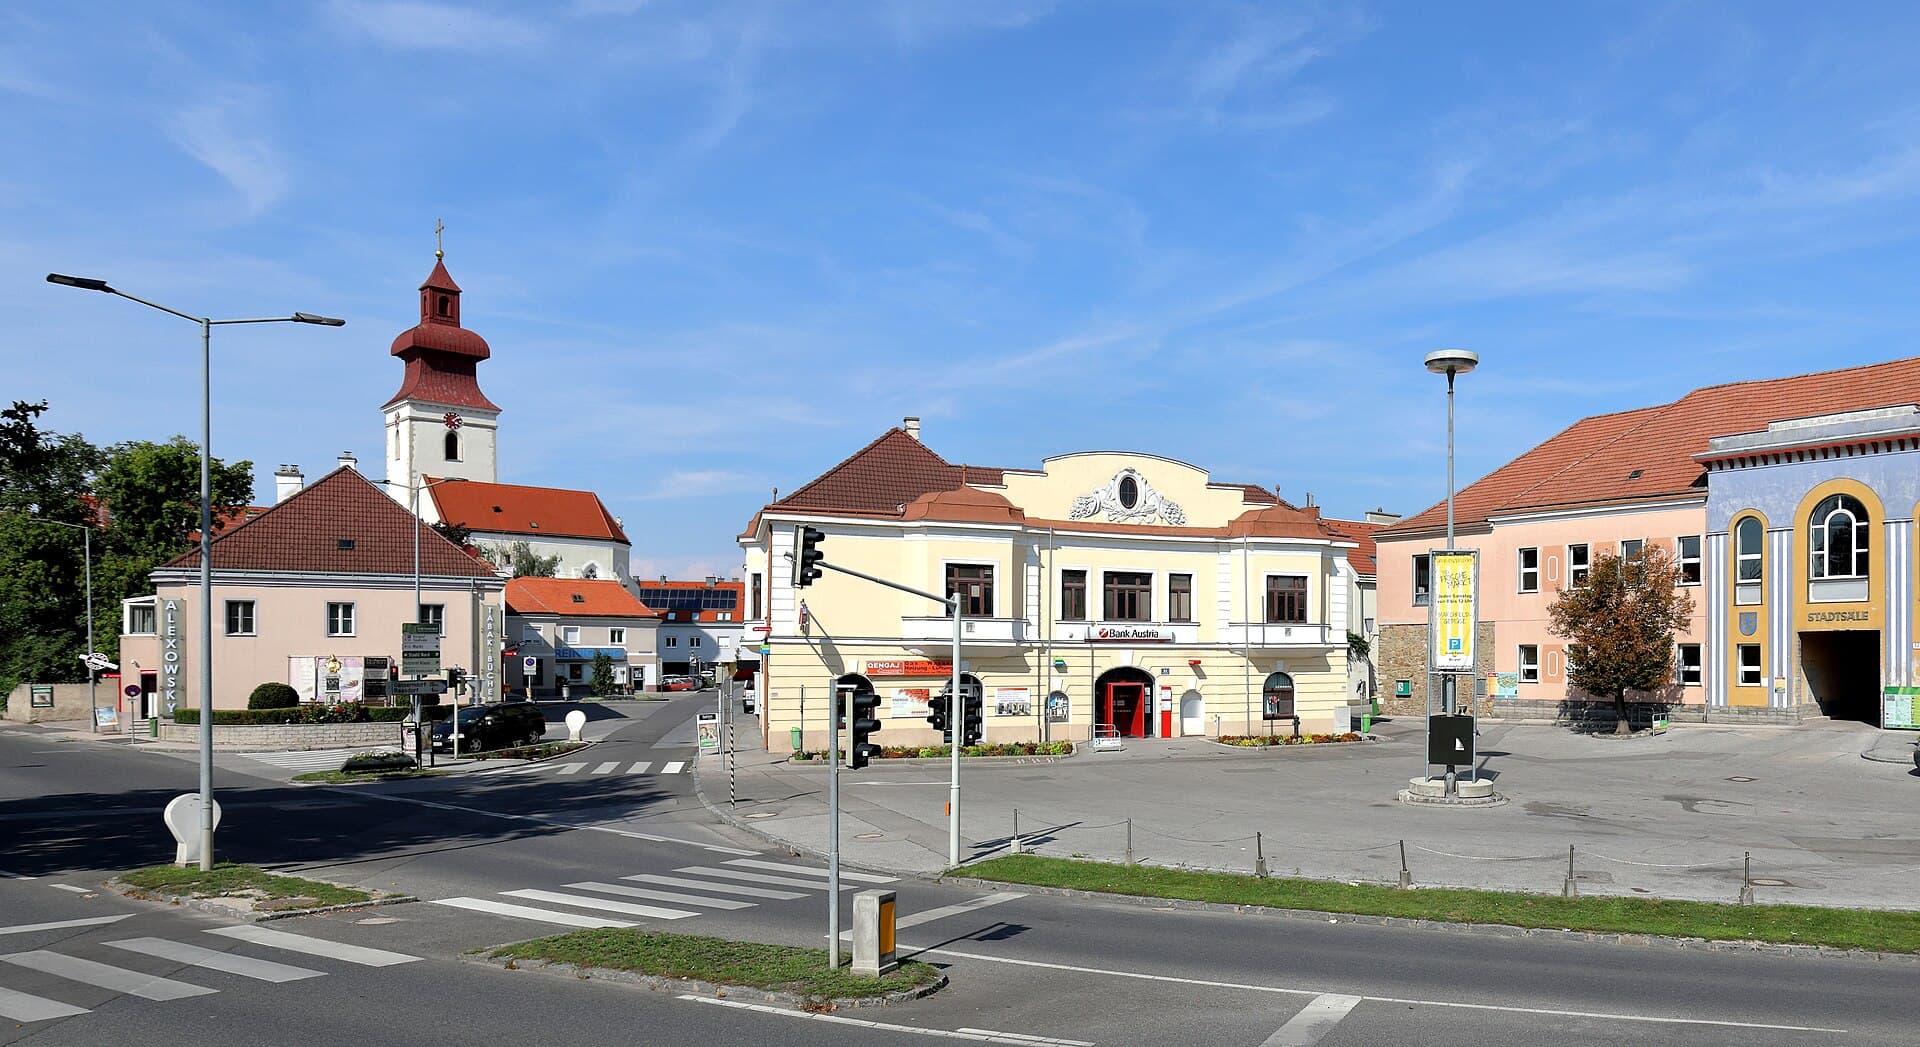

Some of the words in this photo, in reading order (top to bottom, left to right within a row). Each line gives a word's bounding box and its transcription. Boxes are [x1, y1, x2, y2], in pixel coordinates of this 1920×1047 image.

[1109, 629, 1130, 638] Bank
[1132, 629, 1159, 638] Austria
[164, 600, 178, 713] ALEXOWSKY
[554, 648, 624, 659] REINIGNG
